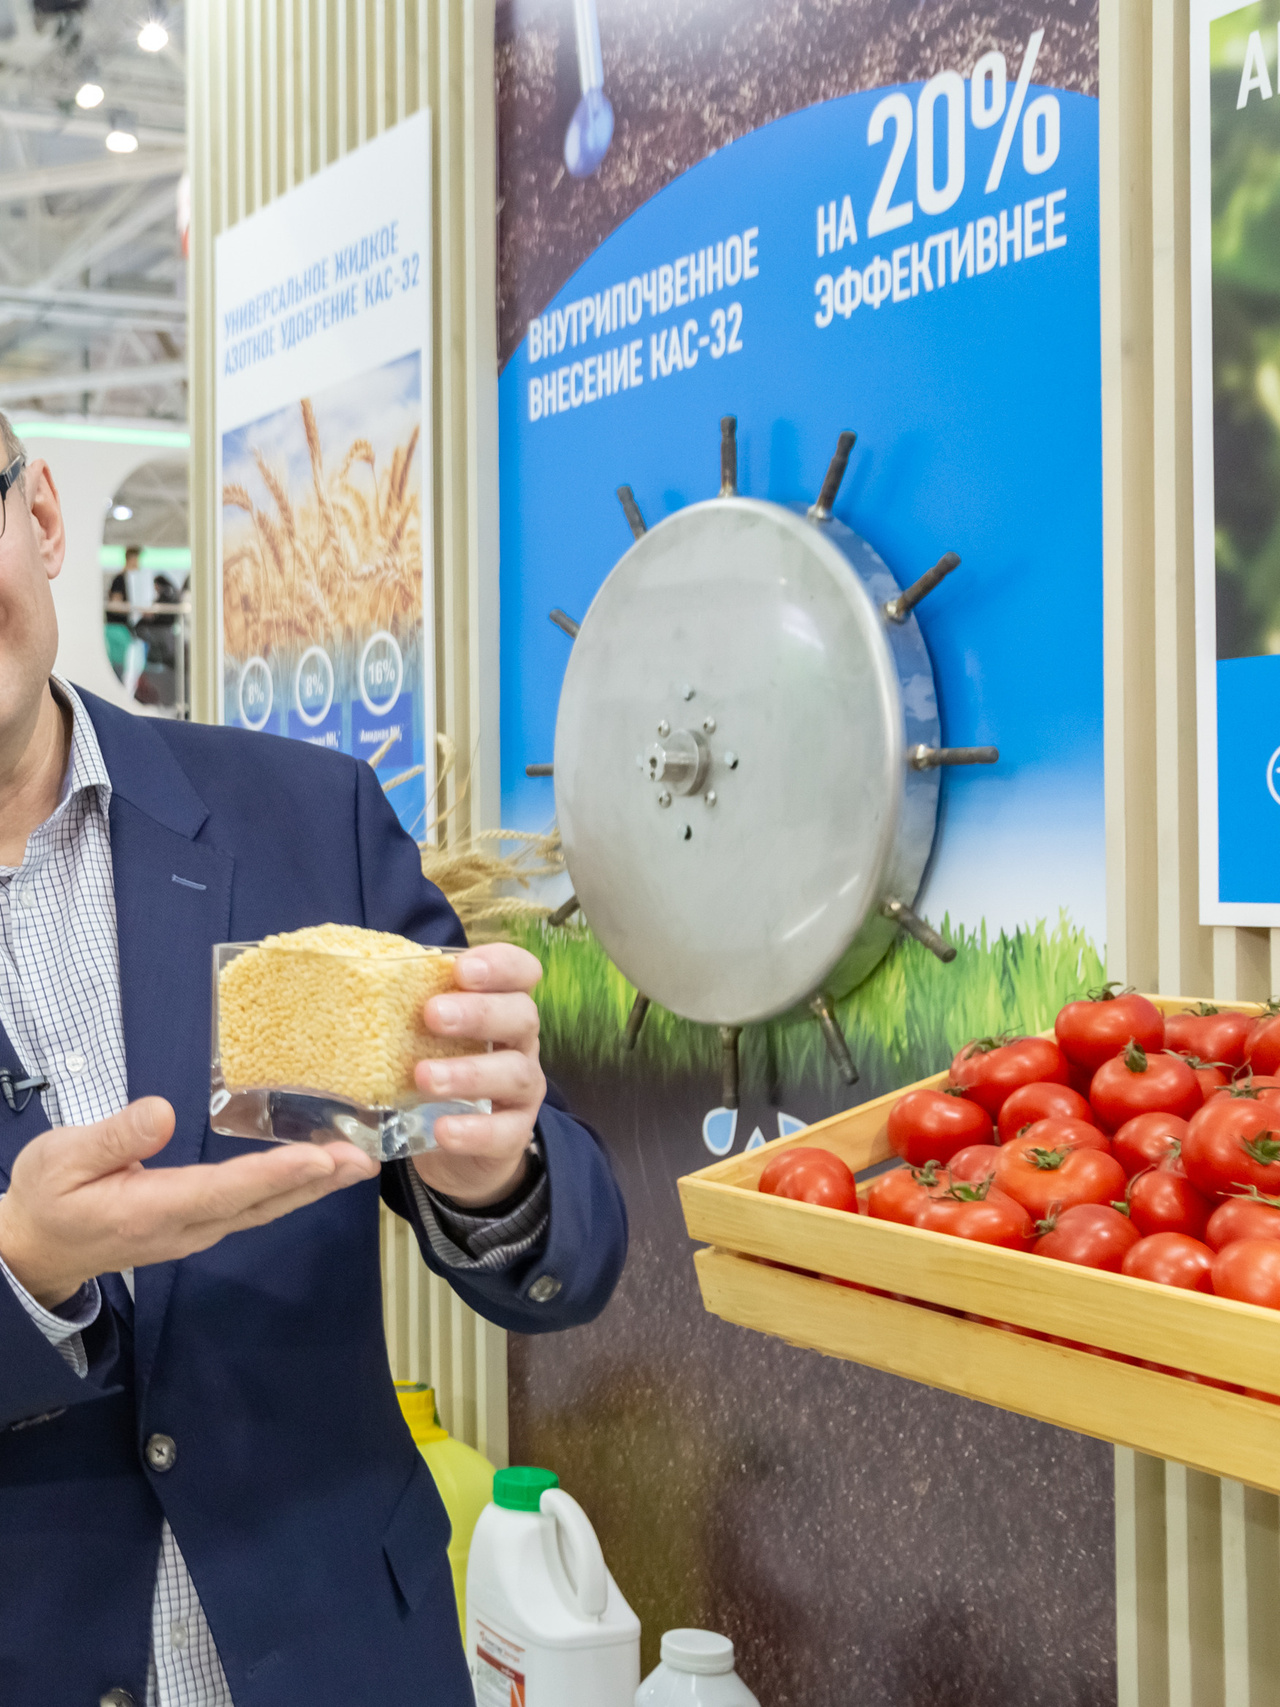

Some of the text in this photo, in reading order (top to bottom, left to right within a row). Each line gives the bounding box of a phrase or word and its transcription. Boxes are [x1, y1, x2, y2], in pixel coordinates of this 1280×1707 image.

[1236, 20, 1280, 110] А
[817, 27, 1061, 258] НА 20%
[224, 220, 399, 341] УНИВЕРСАЛЬНОЕ ЖИДКОЕ
[528, 226, 759, 364] ВНУТРИПОЧВЕННОЕ
[814, 188, 1068, 329] ЭФФЕКТИВНЕЕ
[224, 325, 276, 378] АЗОТНОЕ
[281, 282, 358, 351] УДОБРЕНИЕ
[528, 302, 743, 423] ВНЕСЕНИЕ КАС-32
[306, 672, 324, 699] 8%
[368, 658, 396, 686] 16%
